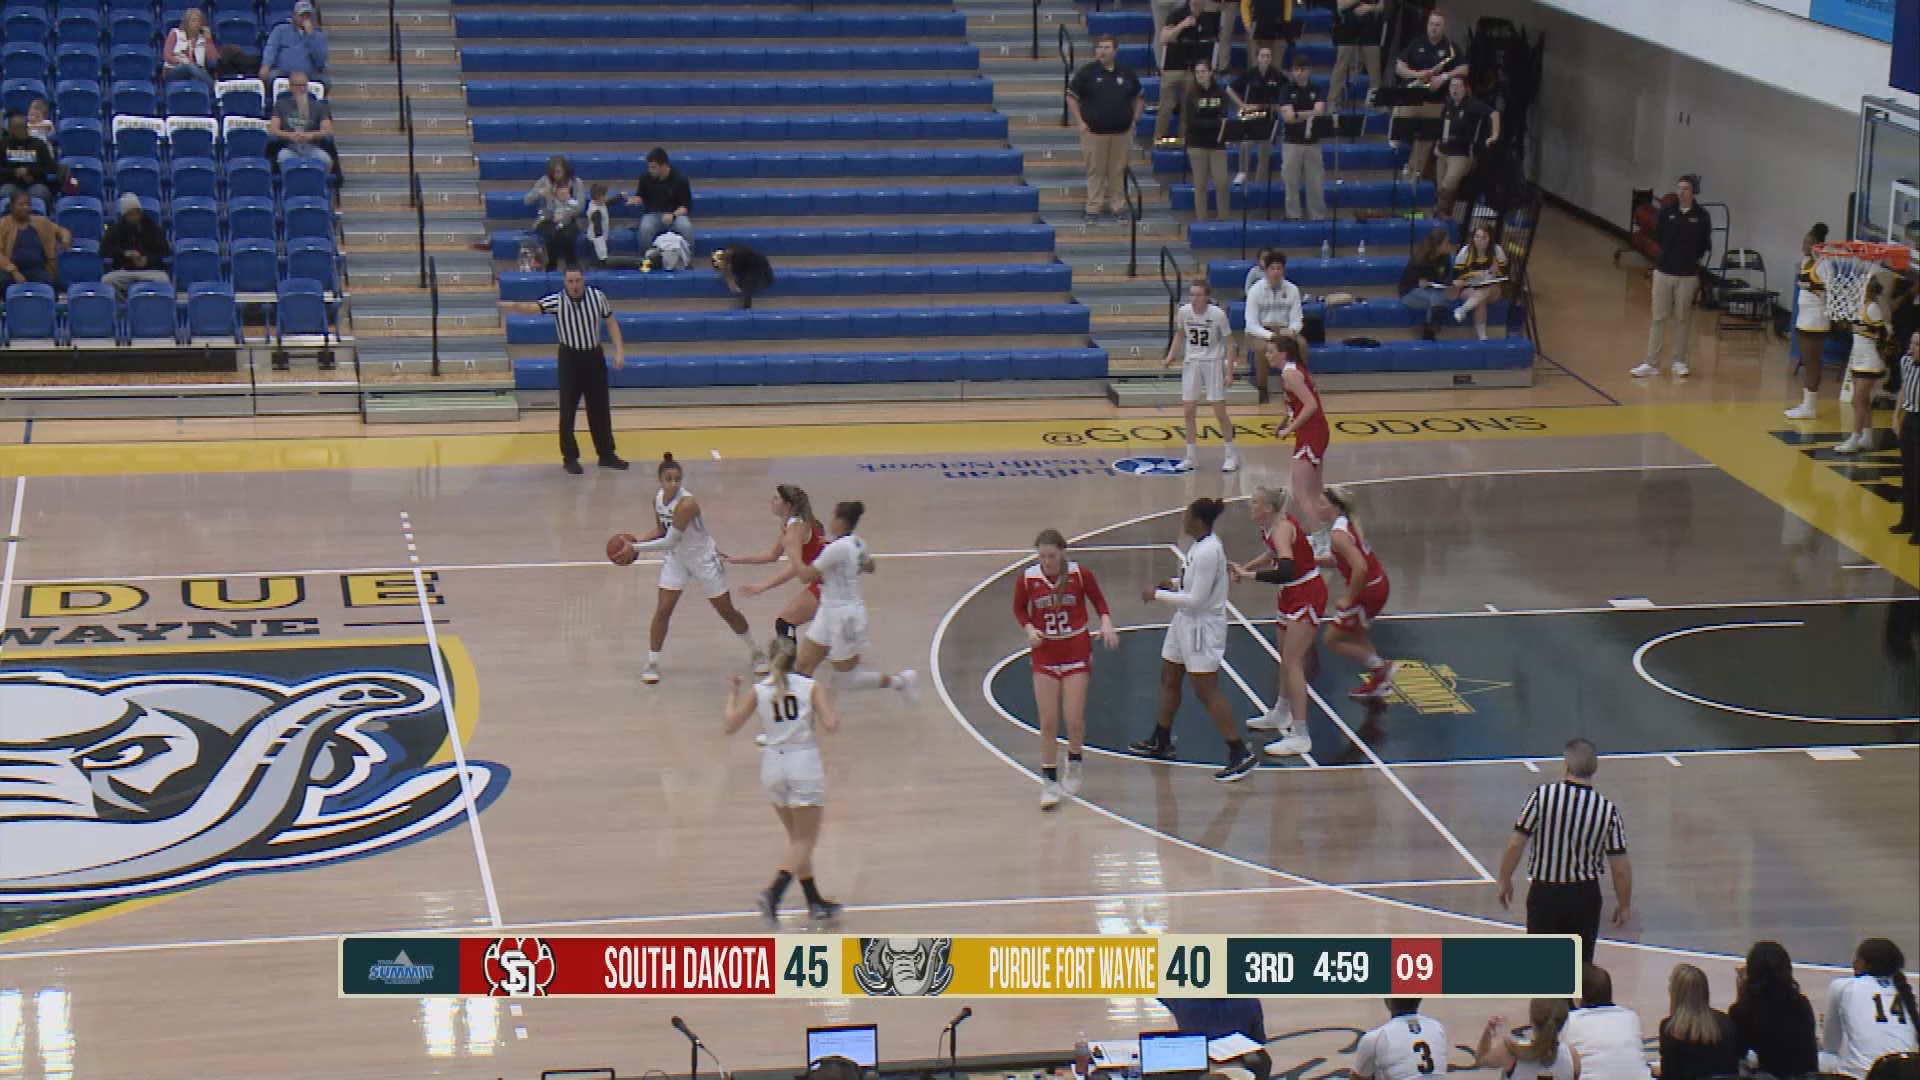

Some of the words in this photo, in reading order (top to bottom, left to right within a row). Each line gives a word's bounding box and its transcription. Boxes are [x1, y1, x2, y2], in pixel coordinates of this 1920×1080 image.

[1189, 327, 1210, 348] 32
[1042, 415, 1548, 447] @GOMASODONS
[1044, 610, 1073, 636] 22
[771, 695, 799, 723] 10
[1871, 991, 1908, 1025] 14
[1412, 1039, 1435, 1075] 3
